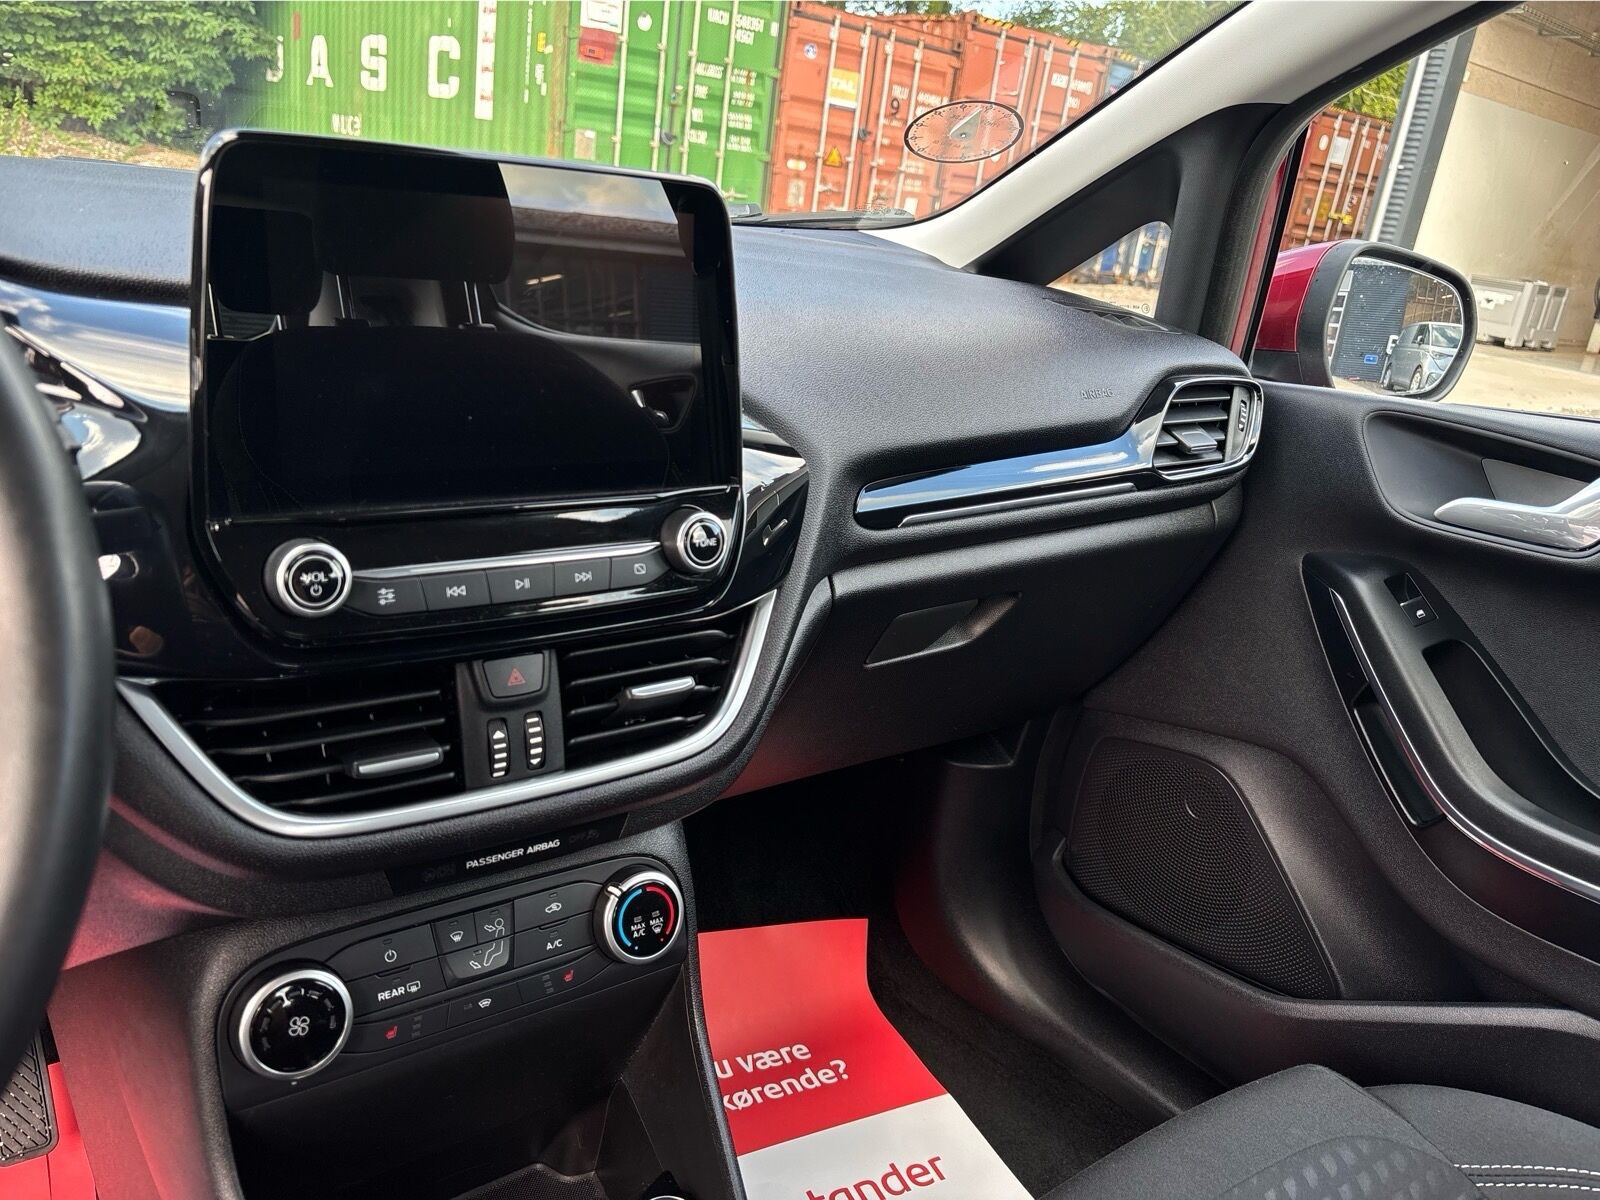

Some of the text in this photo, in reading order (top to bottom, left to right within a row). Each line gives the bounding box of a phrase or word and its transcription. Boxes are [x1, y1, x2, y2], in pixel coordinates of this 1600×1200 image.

[1081, 388, 1113, 400] AIRBAG
[694, 537, 718, 548] TONE
[301, 571, 329, 585] VOL
[466, 839, 561, 869] PASSENGER AIRBAG
[631, 922, 646, 932] MAX
[649, 916, 664, 926] MAX
[633, 928, 646, 939] A/C
[546, 939, 563, 950] A/C
[377, 986, 406, 1002] REAR
[735, 1043, 812, 1073] være
[806, 1155, 946, 1200] nder
